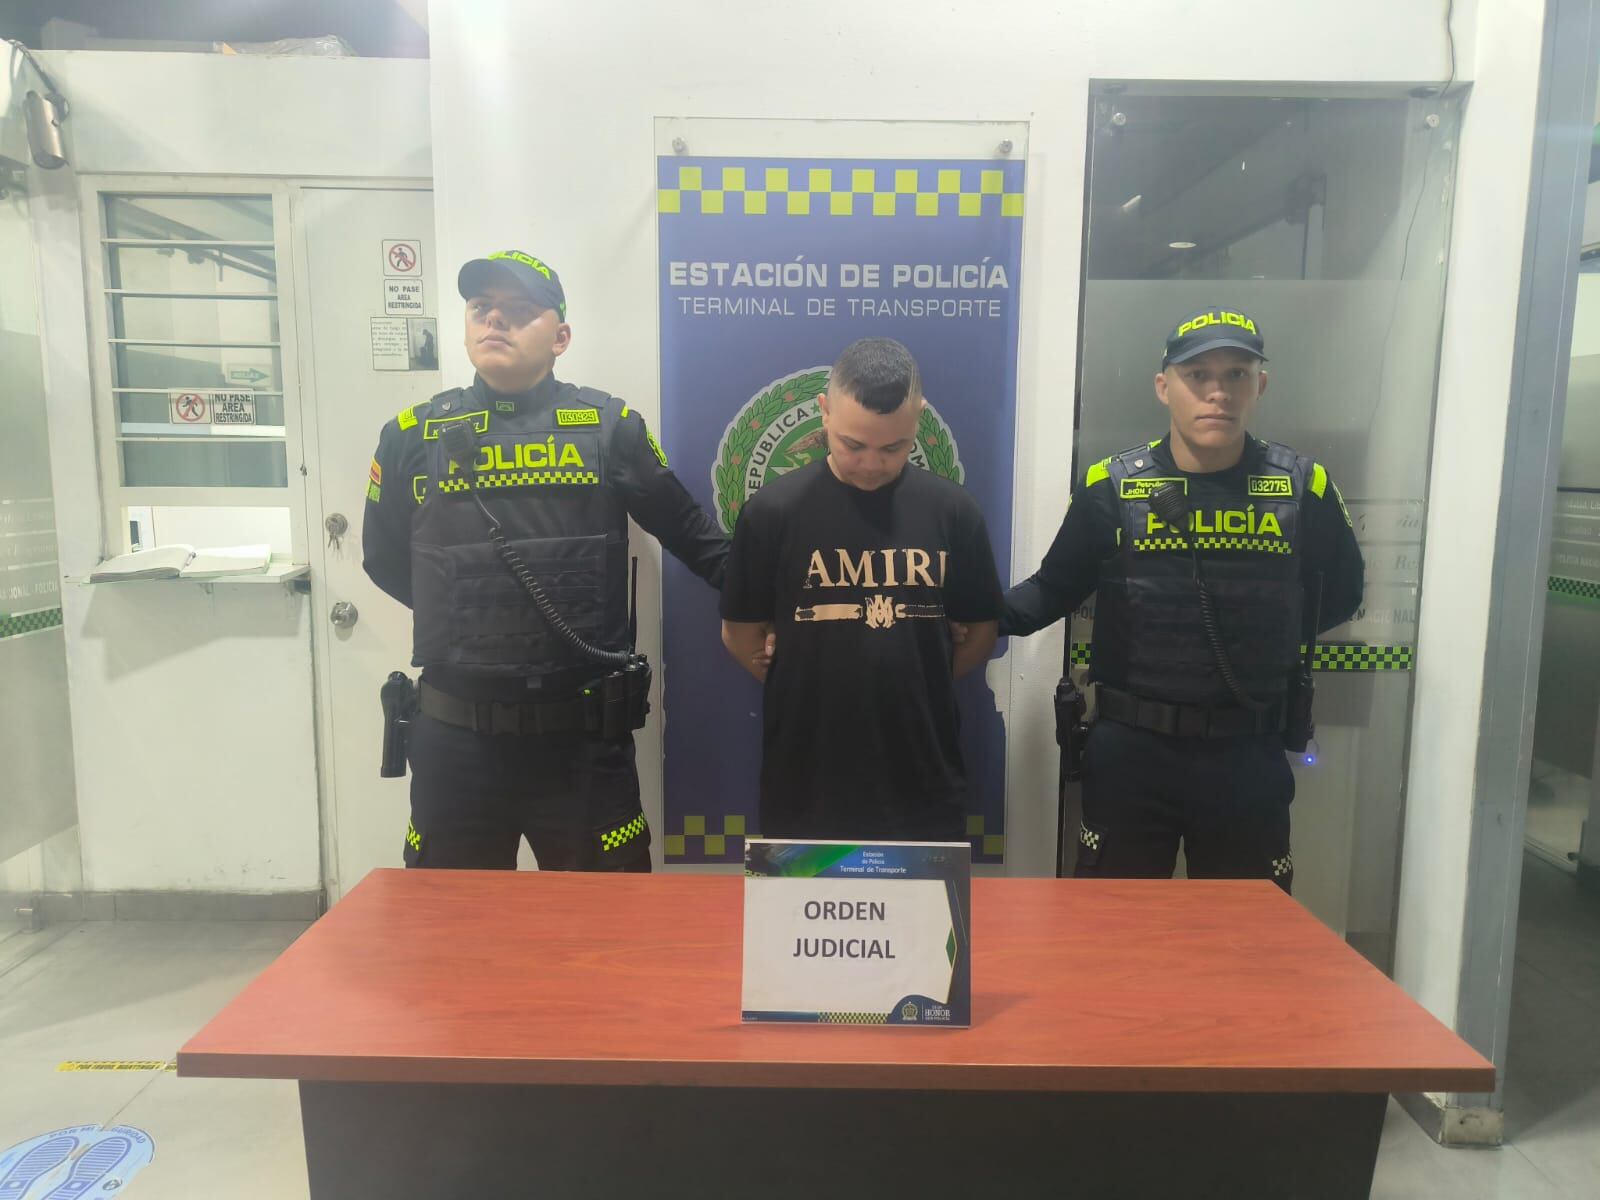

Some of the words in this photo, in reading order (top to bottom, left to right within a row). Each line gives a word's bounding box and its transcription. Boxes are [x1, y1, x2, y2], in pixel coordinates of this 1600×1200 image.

[669, 255, 828, 288] ESTACIÓN
[840, 263, 880, 288] DE
[893, 256, 1009, 289] POLICÍA
[388, 285, 399, 293] NO
[402, 285, 420, 293] PASE
[678, 296, 796, 316] TERMINAL
[807, 298, 836, 316] DE
[848, 298, 1001, 317] TRANSPORTE
[222, 402, 245, 412] AREA
[229, 393, 252, 402] PASE
[748, 407, 810, 500] EPÚBLICA
[1251, 479, 1288, 493] 032775
[803, 548, 949, 589] AMIRI
[840, 865, 865, 873] Terminal
[804, 900, 886, 921] ORDEN
[793, 938, 896, 959] JUDICIAL
